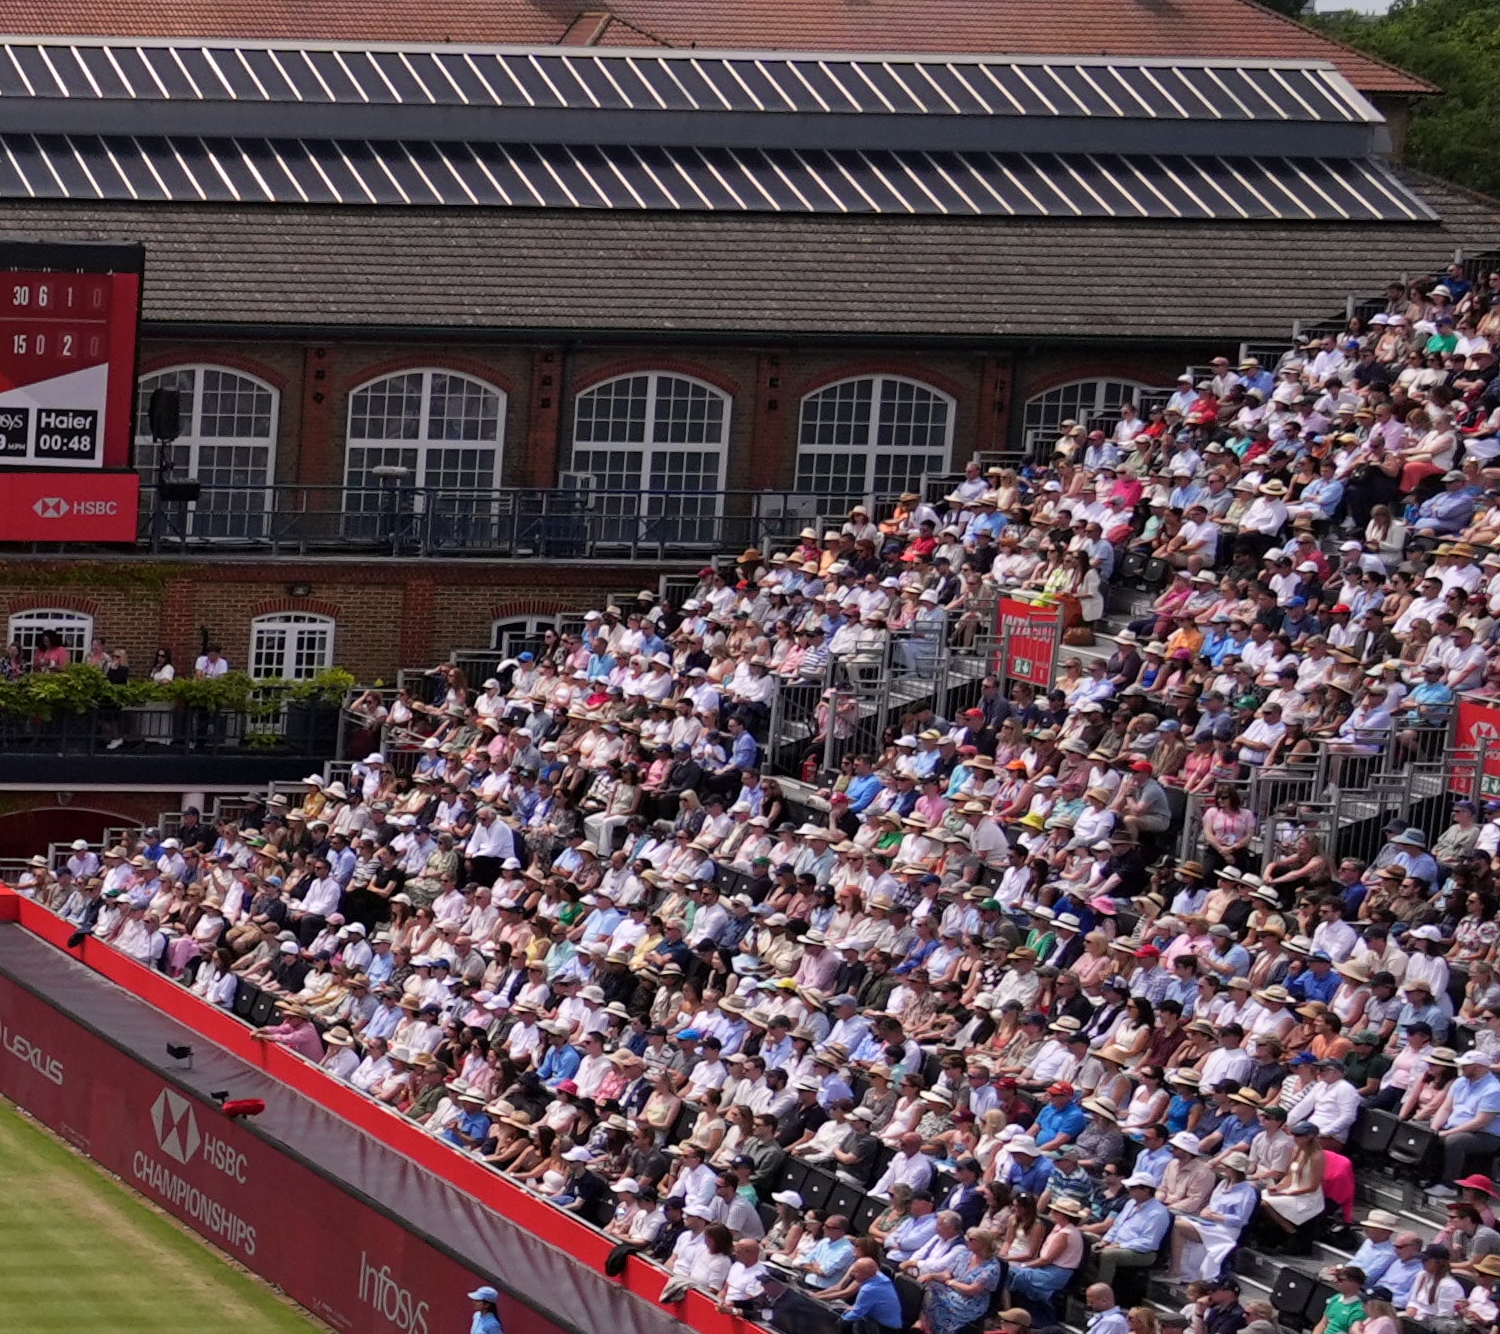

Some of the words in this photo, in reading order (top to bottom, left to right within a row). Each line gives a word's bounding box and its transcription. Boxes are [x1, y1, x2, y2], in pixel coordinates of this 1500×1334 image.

[13, 285, 30, 306] 30
[38, 285, 48, 307] 6
[67, 287, 73, 308] 1
[13, 334, 28, 355] 15
[36, 334, 46, 355] 0
[62, 335, 73, 356] 2
[40, 412, 93, 430] Haier
[39, 434, 92, 452] 00:48
[73, 501, 118, 516] HSBC
[3, 1025, 65, 1087] LEXUS
[203, 1132, 248, 1185] HSBC
[133, 1150, 257, 1256] CHAMPIONSHIPS
